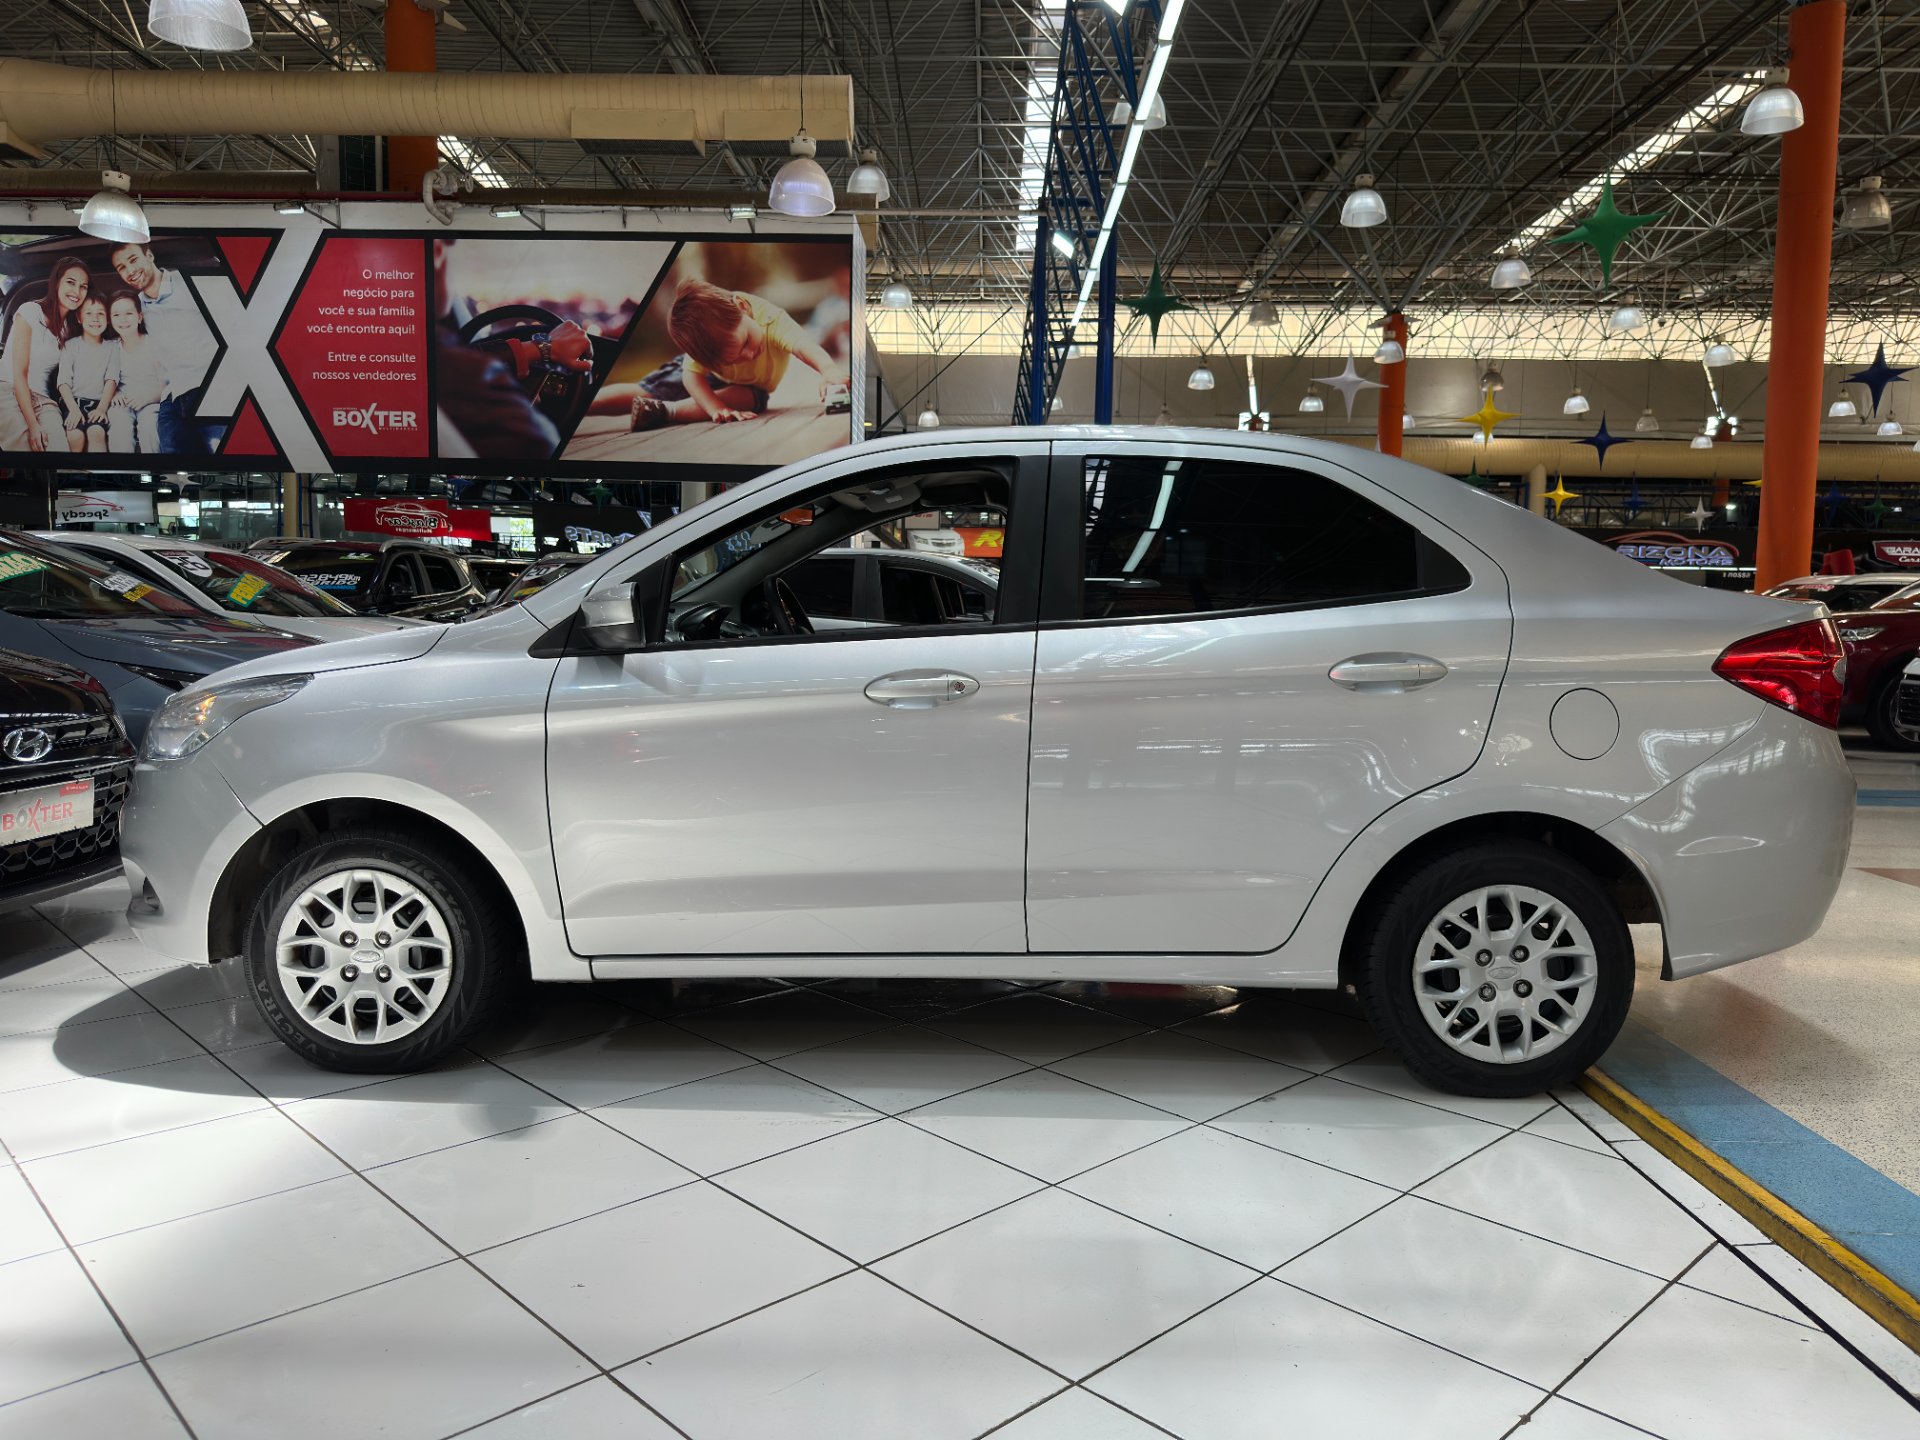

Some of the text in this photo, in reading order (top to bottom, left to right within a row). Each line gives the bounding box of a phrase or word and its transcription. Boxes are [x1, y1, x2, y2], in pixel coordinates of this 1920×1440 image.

[362, 268, 415, 280] O melhor
[343, 286, 415, 300] negócio para
[318, 304, 415, 317] você e sua família
[306, 322, 416, 336] você encontra aqui!
[327, 351, 416, 363] Entre e consulte
[312, 370, 417, 382] nossos vendedores
[333, 403, 417, 434] BOXTER
[2, 798, 73, 833] BOXTER
[257, 978, 318, 1053] VECTRA
